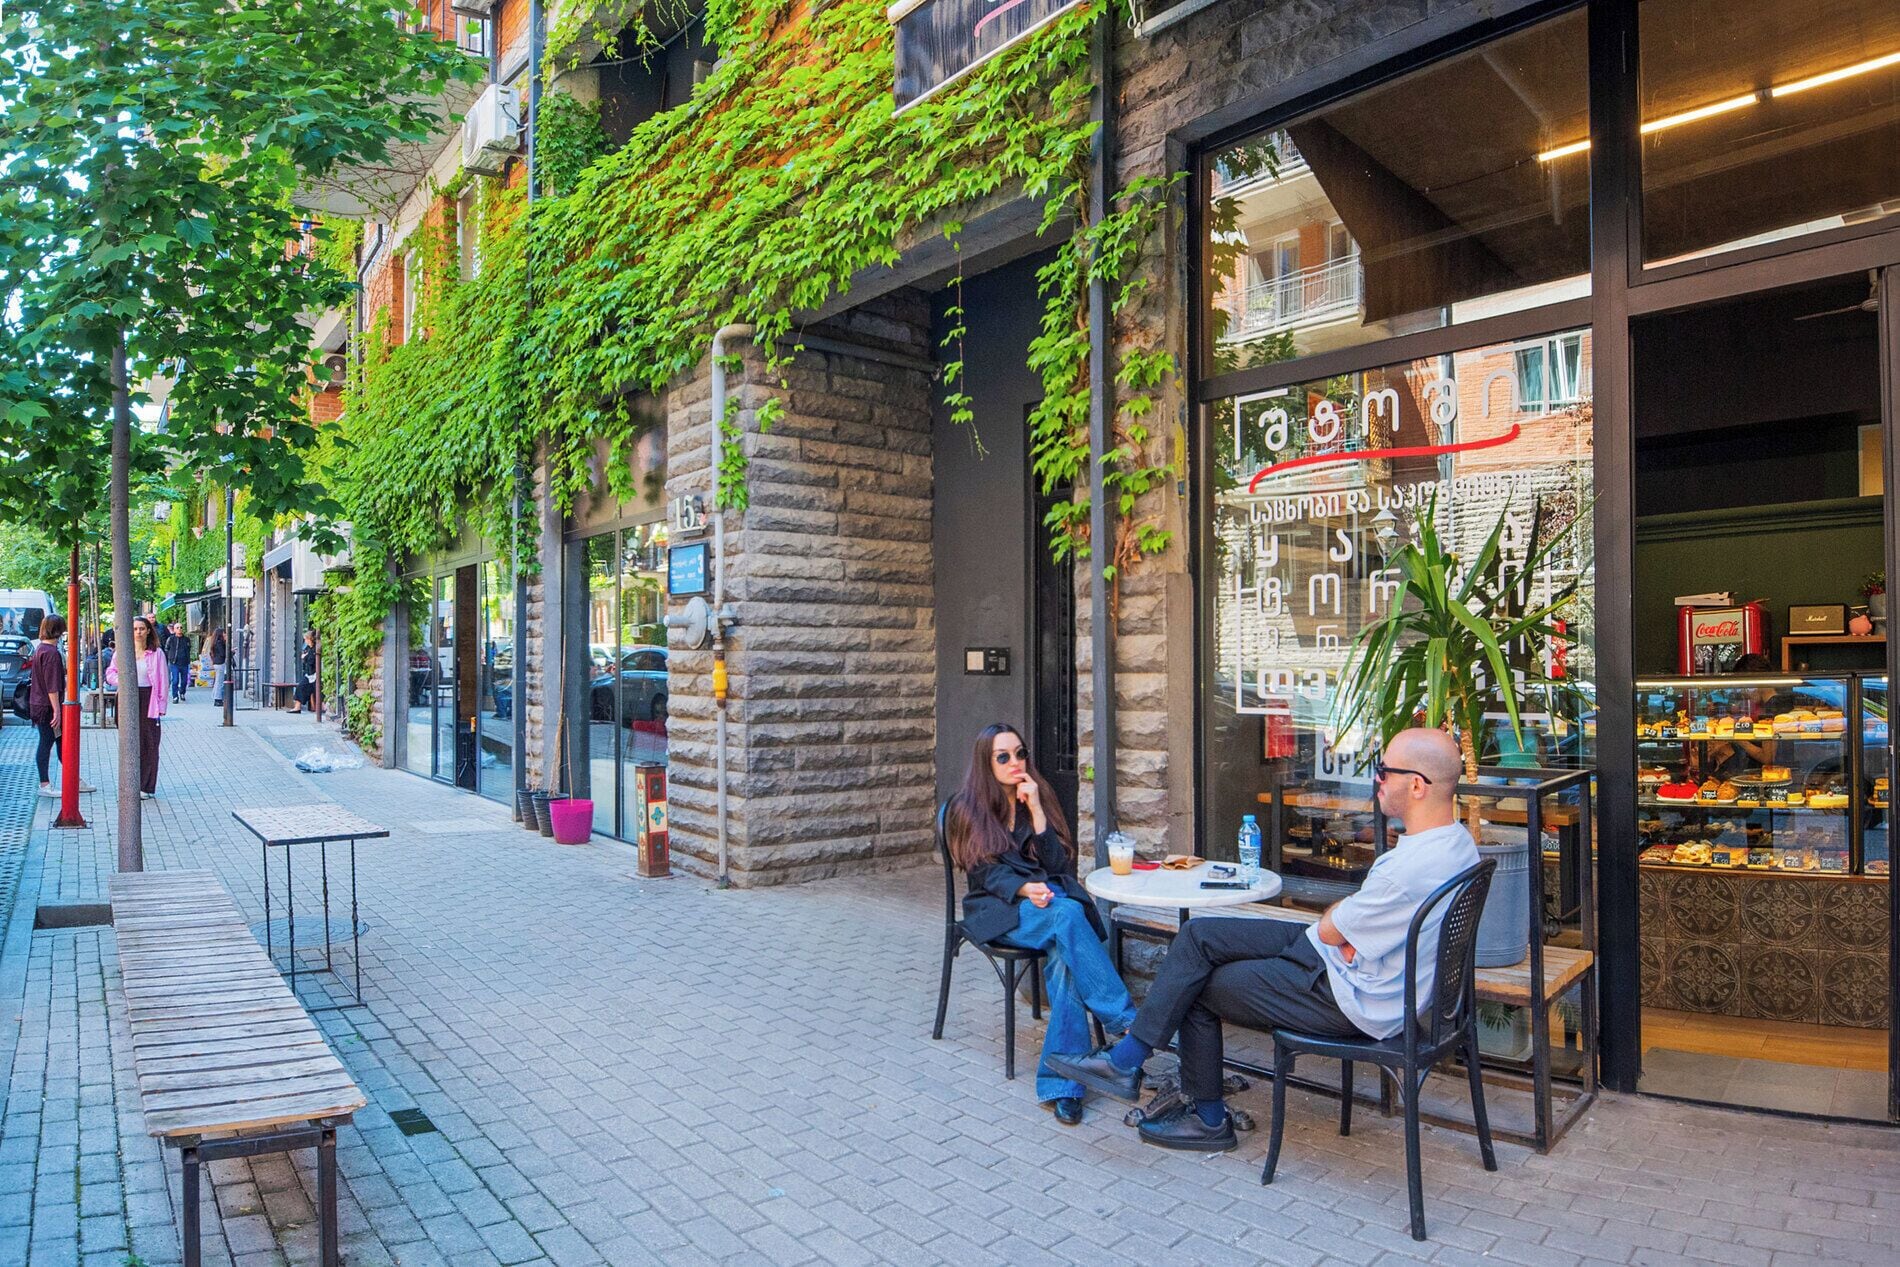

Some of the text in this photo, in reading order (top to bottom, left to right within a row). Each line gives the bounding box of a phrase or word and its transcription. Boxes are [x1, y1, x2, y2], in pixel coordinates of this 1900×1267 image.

[1258, 368, 1519, 451] შტოში
[675, 494, 695, 530] 15
[1250, 493, 1340, 524] საცხობი
[1346, 490, 1370, 514] და
[1695, 620, 1740, 638] Coca-Cola
